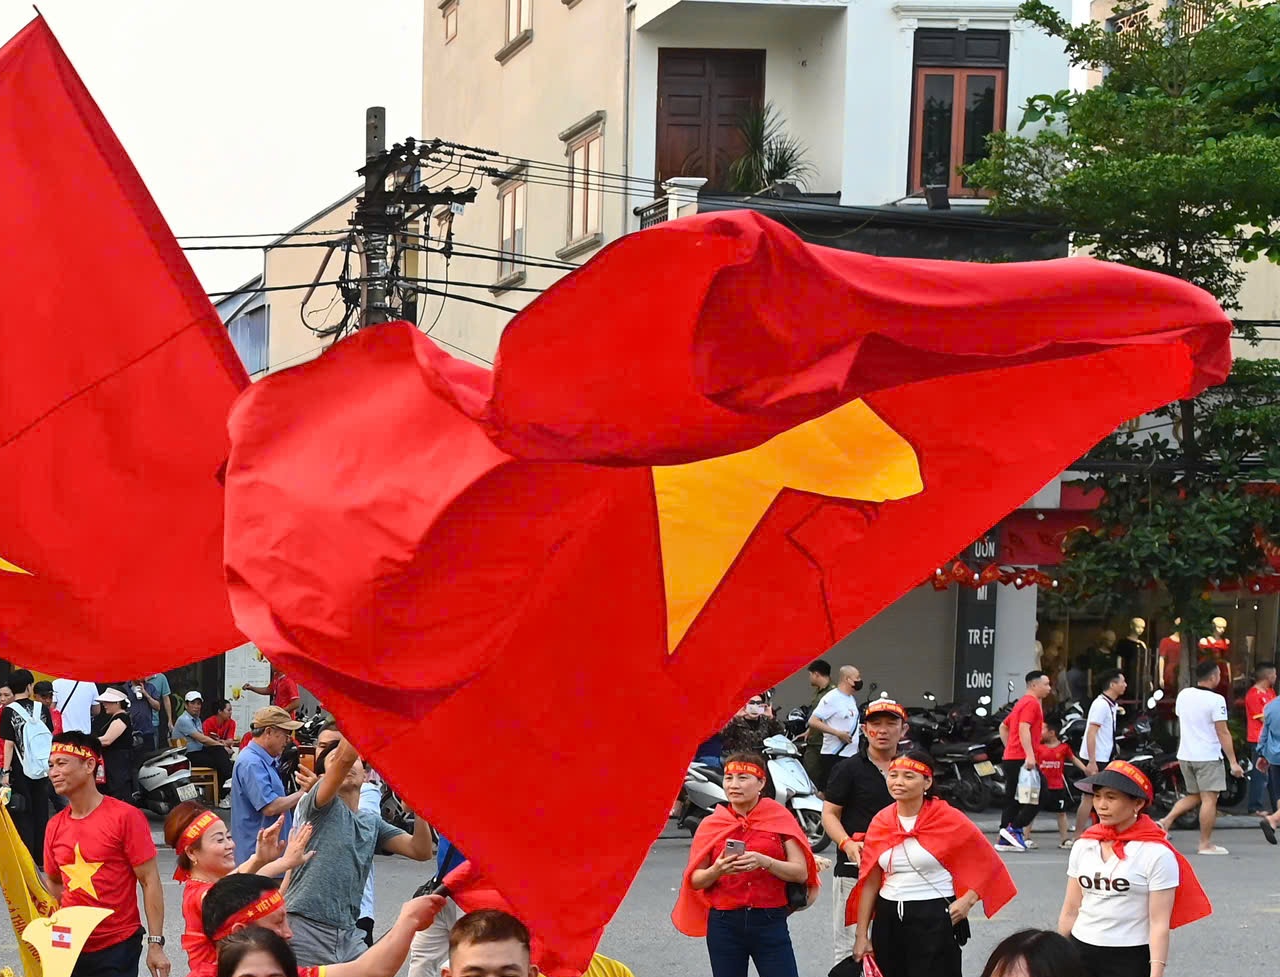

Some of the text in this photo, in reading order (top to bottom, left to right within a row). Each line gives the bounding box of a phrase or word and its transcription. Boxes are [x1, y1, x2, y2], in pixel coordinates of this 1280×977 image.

[974, 536, 995, 557] UỐN
[966, 669, 992, 689] LÔNG
[1058, 800, 1065, 809] 7
[186, 813, 213, 839] VIỆT NAM
[255, 899, 271, 914] VIỆT
